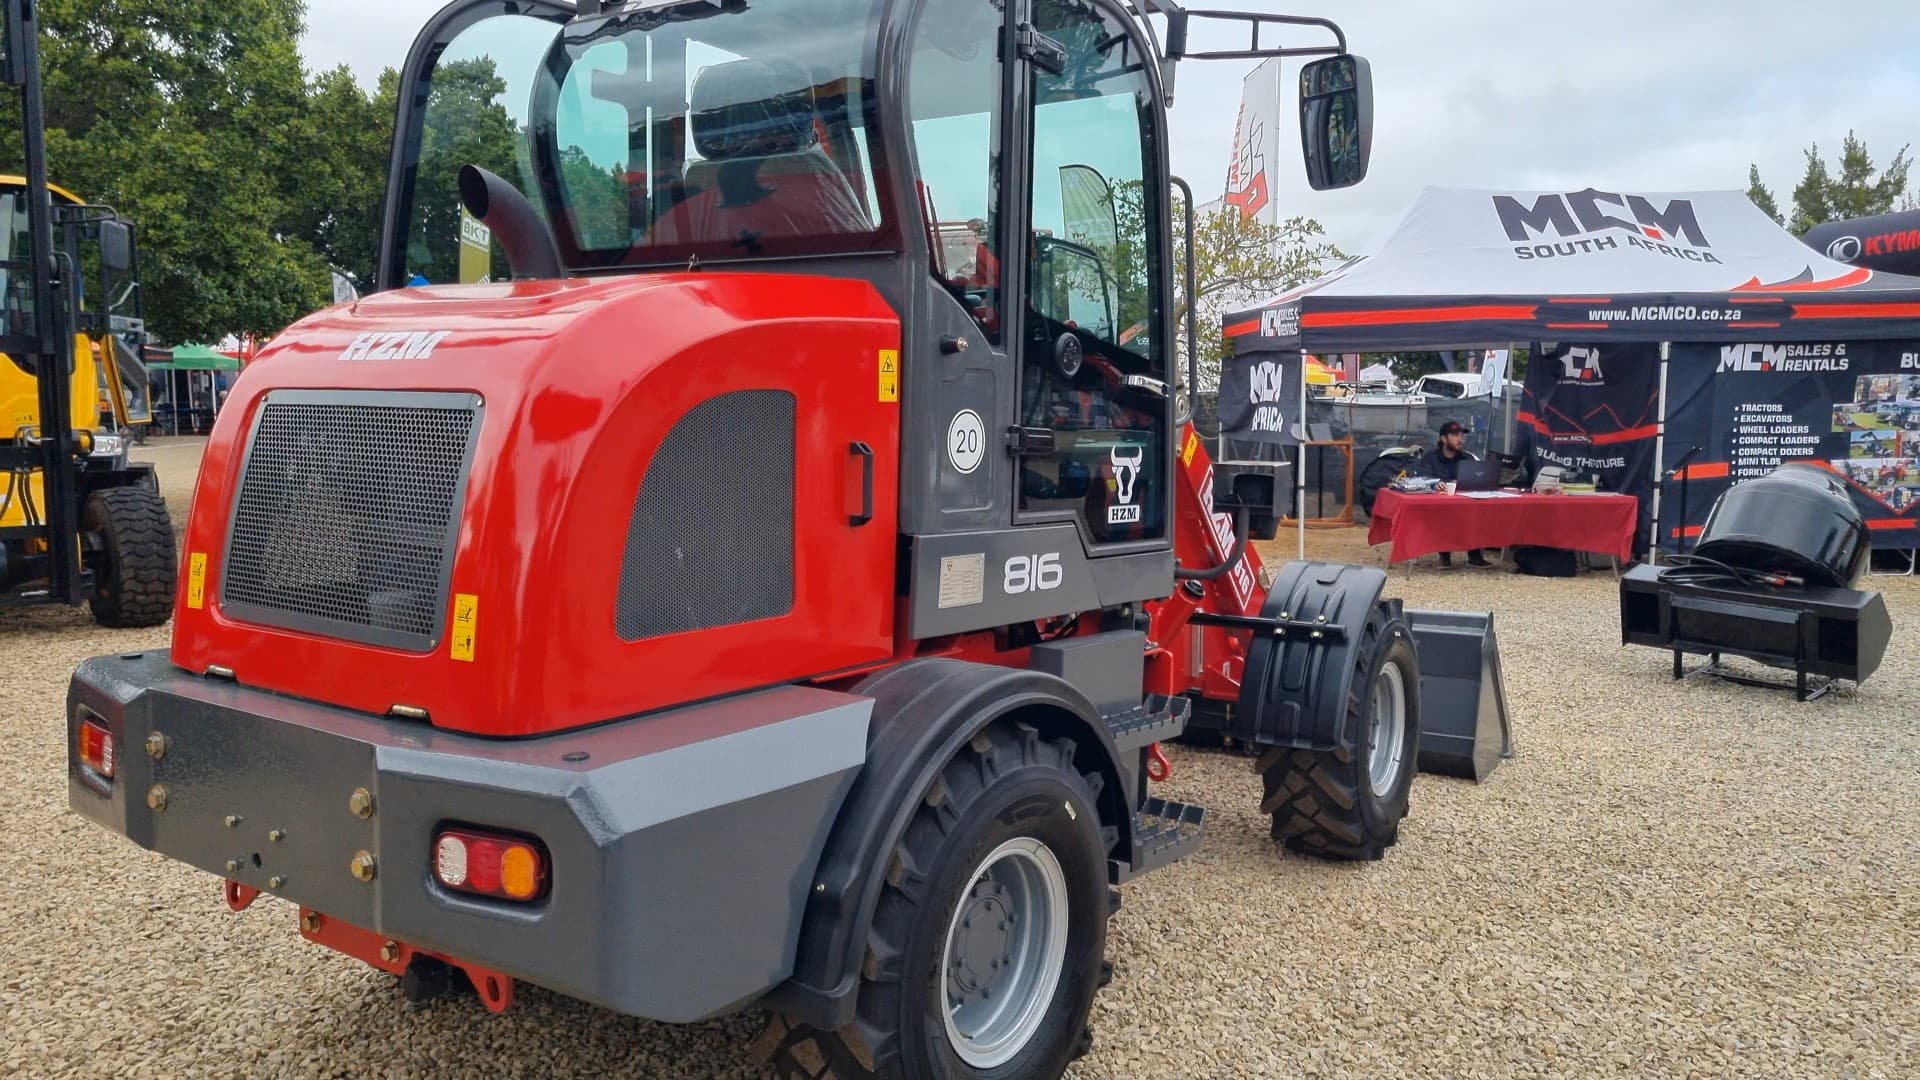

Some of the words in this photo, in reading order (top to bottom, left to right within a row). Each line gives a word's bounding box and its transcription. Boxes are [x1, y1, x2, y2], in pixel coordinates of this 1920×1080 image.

[1492, 188, 1711, 248] MCM
[464, 220, 488, 242] BKT
[1514, 236, 1618, 260] SOUTH
[1627, 235, 1724, 264] AFRICA
[1588, 307, 1742, 321] www.MCMCO.co.za
[338, 331, 451, 360] HZM
[1716, 344, 1787, 372] MCM
[1787, 344, 1831, 356] SALES
[1835, 344, 1846, 355] &
[1785, 358, 1849, 371] RENTALS
[1741, 404, 1783, 412] TRACTORS
[1740, 415, 1793, 423] EXCAVATORS
[1739, 426, 1769, 434] WHEEL
[1770, 426, 1809, 434] LOADERS
[956, 429, 978, 453] 20
[1738, 437, 1778, 445] COMPACT
[1780, 436, 1820, 444] LOADERS
[1738, 448, 1778, 456] COMPACT
[1779, 447, 1814, 455] DOZERS
[1738, 458, 1759, 466] MINI
[1112, 508, 1137, 521] HZM
[1003, 552, 1063, 594] 816
